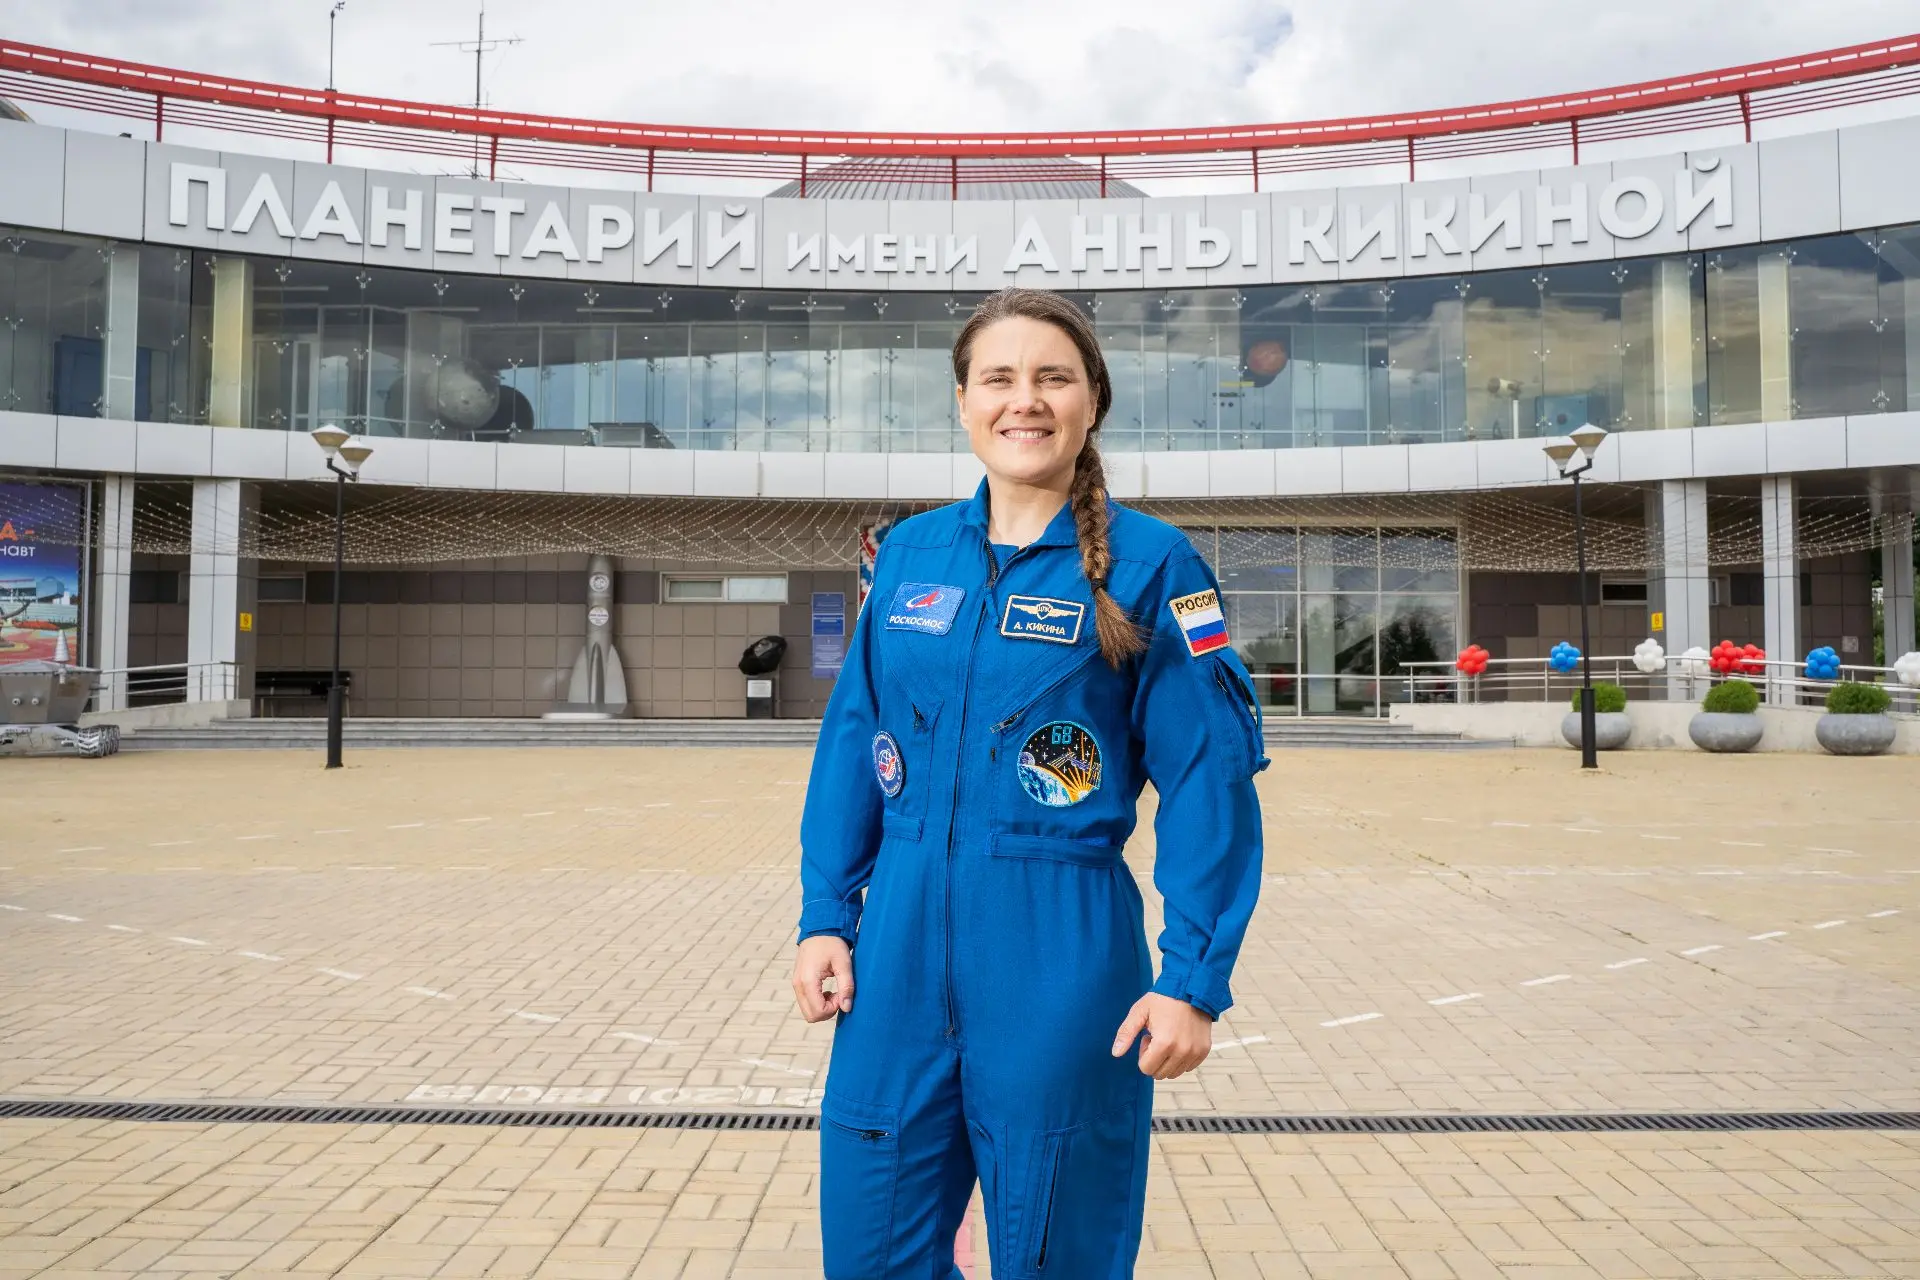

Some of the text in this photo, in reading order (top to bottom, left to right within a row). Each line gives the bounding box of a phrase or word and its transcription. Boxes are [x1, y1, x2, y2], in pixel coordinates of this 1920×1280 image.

[170, 162, 757, 269] ПЛАНЕТАРИЙ
[1003, 209, 1258, 273] АННЫ
[1288, 156, 1733, 265] КИКИНОЙ
[889, 615, 945, 629] РОСКОСМОС
[1013, 621, 1066, 636] А. КИКИНА
[1051, 725, 1073, 745] 68
